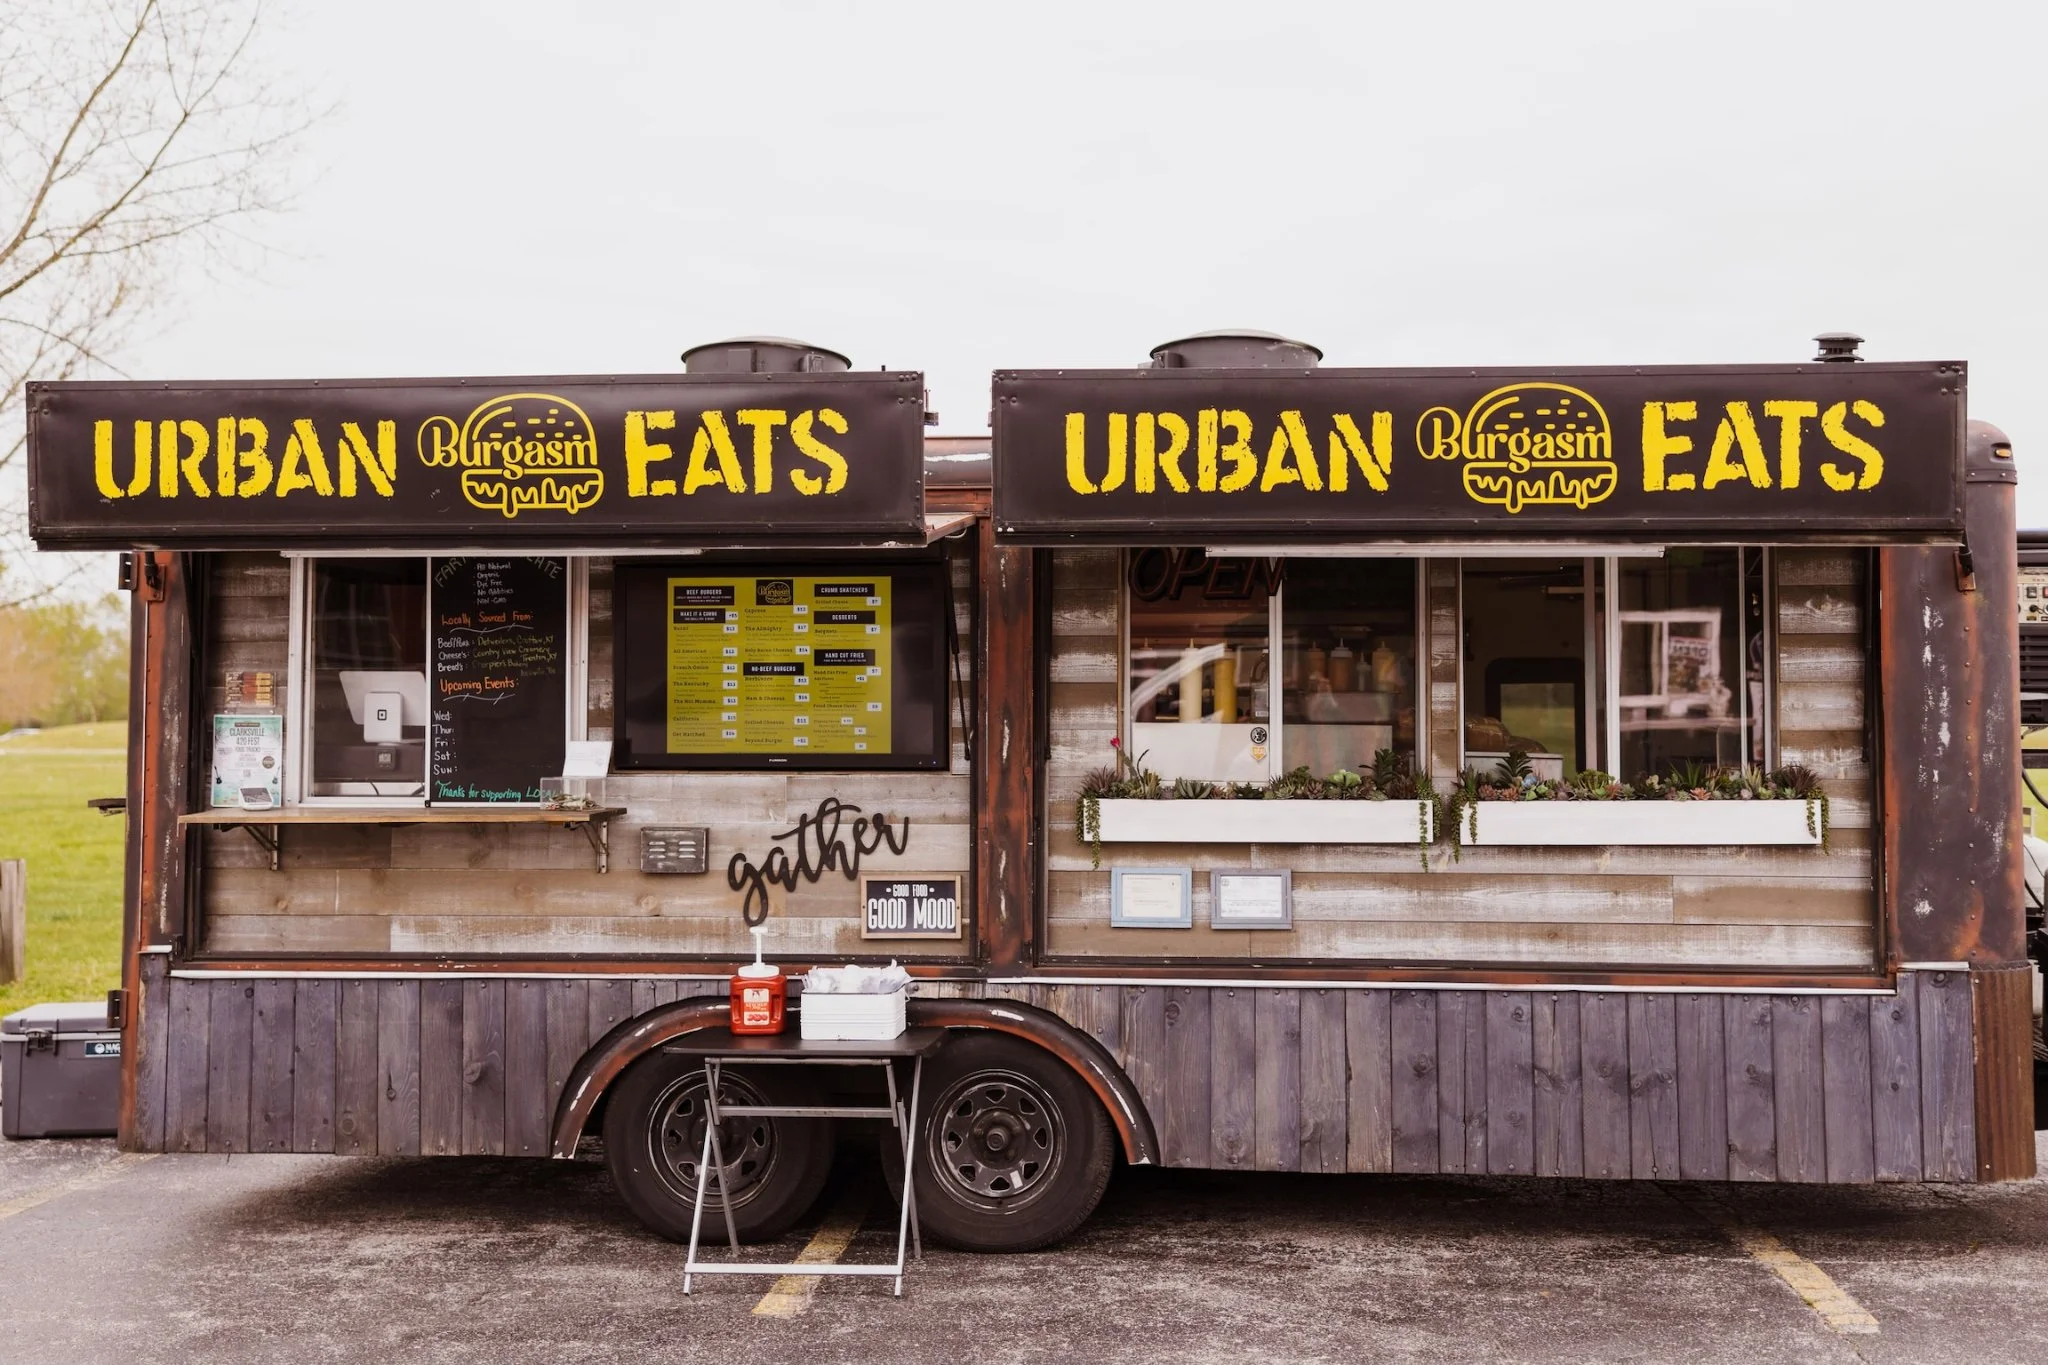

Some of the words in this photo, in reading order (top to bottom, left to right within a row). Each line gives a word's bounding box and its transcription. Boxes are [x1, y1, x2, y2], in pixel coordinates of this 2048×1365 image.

[94, 416, 397, 500] URBAN
[417, 415, 598, 480] Burgasm
[624, 408, 850, 498] EATS
[1064, 409, 1393, 496] URBAN
[1416, 406, 1612, 474] Burgasm
[1641, 399, 1886, 493] EATS
[1131, 546, 1287, 600] OPEN
[441, 612, 471, 627] Locally
[478, 611, 506, 623] Sourced
[440, 679, 481, 695] Upcoming
[229, 727, 265, 737] CLARKSVILLE
[435, 780, 465, 798] Thanks
[468, 783, 480, 798] for
[481, 788, 521, 802] supporting
[728, 797, 909, 927] gather
[893, 884, 909, 897] GOOD
[912, 884, 928, 897] FOOD
[868, 898, 907, 930] GOOD
[913, 898, 956, 930] MOOD
